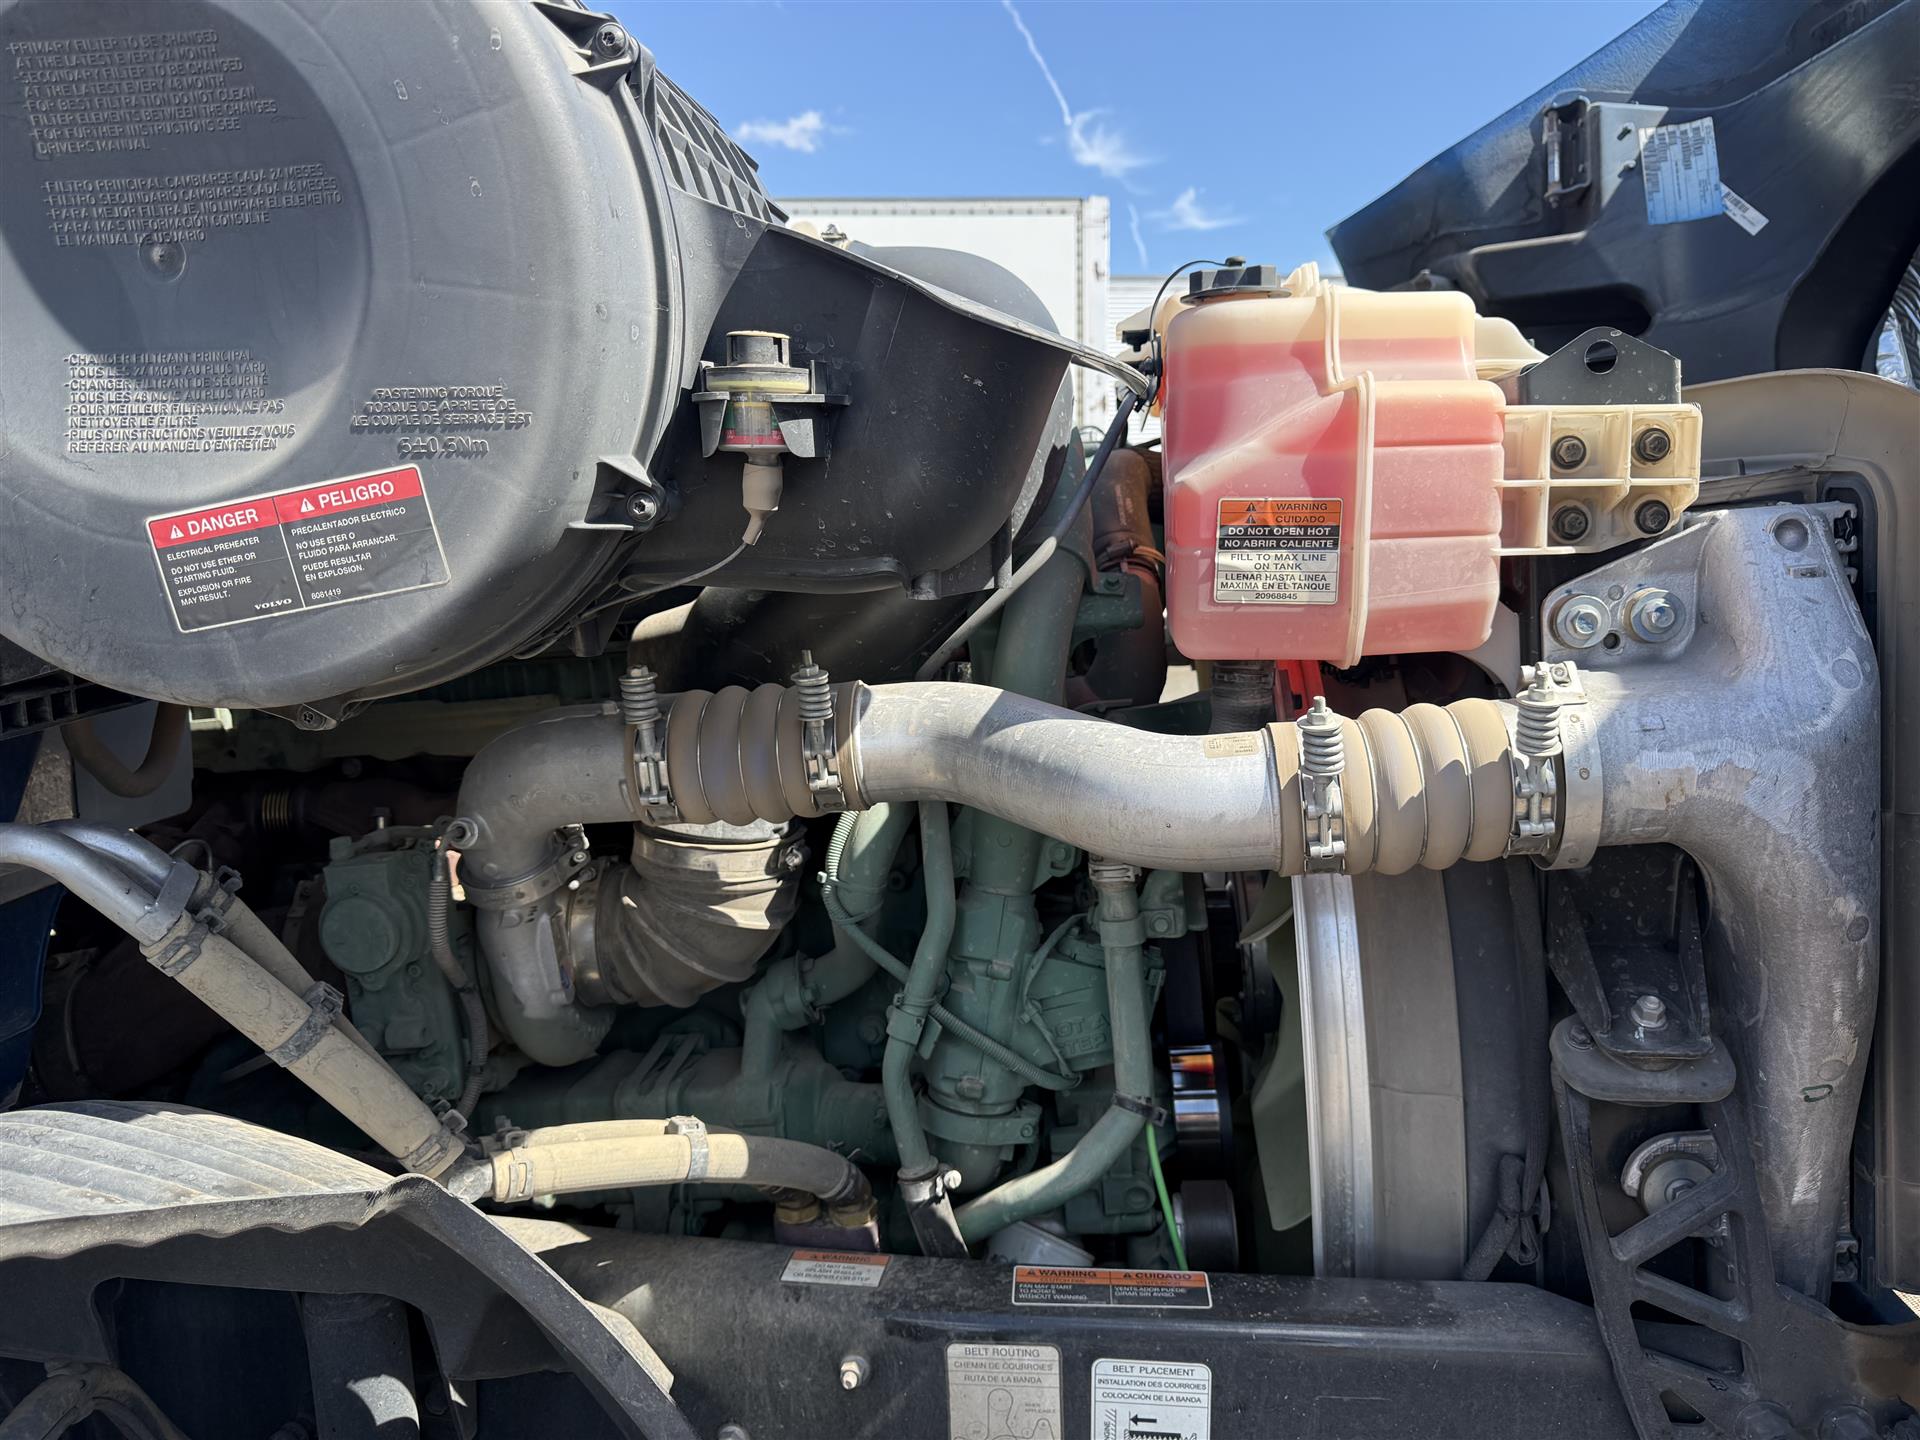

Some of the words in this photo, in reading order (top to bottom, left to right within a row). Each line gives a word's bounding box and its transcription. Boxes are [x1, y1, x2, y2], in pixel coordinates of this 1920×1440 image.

[375, 387, 448, 398] FASTENING
[450, 385, 504, 398] TORQUE
[108, 404, 168, 416] MEILLEUR
[242, 400, 260, 414] NE
[260, 399, 284, 414] PAS
[70, 417, 136, 428] NETTOYER
[140, 417, 154, 428] LE
[157, 416, 198, 428] FILTRE
[352, 415, 370, 426] LE
[372, 414, 420, 426] COUPLE
[423, 414, 441, 426] DE
[443, 412, 505, 425] SERRAGE
[508, 412, 533, 424] EST
[106, 428, 205, 442] D'INSTRUCTIONS
[208, 426, 262, 440] VEUILLEZ
[264, 424, 296, 439] VOUS
[132, 442, 148, 453] AU
[152, 440, 200, 453] MANUEL
[204, 439, 277, 452] D'ENTRETIEN
[318, 480, 394, 508] PELIGRO
[1276, 503, 1328, 511] WARNING
[187, 508, 259, 536] DANGER
[291, 516, 360, 536] PRECALENTADOR
[361, 506, 406, 523] ELECTRICO
[1276, 515, 1326, 524] CUIDADO
[1228, 528, 1244, 536] DO
[1248, 528, 1270, 536] NOT
[1273, 528, 1304, 536] OPEN
[1307, 528, 1332, 536] HOT
[296, 540, 308, 550] NO
[310, 538, 325, 548] USE
[326, 534, 348, 544] ETER
[348, 532, 356, 540] O
[298, 548, 328, 560] FLUIDO
[328, 543, 351, 554] PARA
[352, 534, 398, 550] ARRANCAR.
[1224, 540, 1241, 548] NO
[1243, 540, 1277, 548] ABRIR
[167, 545, 214, 561] ELECTRICAL
[214, 536, 260, 552] PREHEATER
[171, 566, 183, 576] DO
[184, 563, 200, 574] NOT
[201, 558, 217, 568] USE
[218, 554, 244, 566] ETHER
[244, 552, 256, 561] OR
[302, 560, 330, 572] PUEDE
[330, 552, 372, 566] RESULTAR
[1254, 562, 1270, 570] ON
[1273, 562, 1302, 570] TANK
[174, 570, 212, 585] STARTING
[212, 566, 238, 578] FLUID.
[305, 573, 317, 582] EN
[318, 564, 365, 580] EXPLOSION.
[1265, 574, 1296, 582] HASTA
[178, 582, 220, 597] EXPLOSION
[222, 578, 234, 588] OR
[234, 576, 252, 586] FIRE
[1292, 582, 1331, 590] TANQUE
[180, 596, 198, 607] MAY
[198, 590, 230, 603] RESULT.
[254, 598, 292, 610] VOLVO
[1040, 1270, 1097, 1278] WARNING
[964, 1346, 989, 1356] BELT
[992, 1348, 1040, 1358] ROUTING
[954, 1360, 986, 1369] CHEMIN
[1002, 1362, 1053, 1371] COURROIES
[1113, 1364, 1135, 1374] BELT
[1140, 1366, 1196, 1376] PLACEMENT
[964, 1374, 987, 1382] RUTA
[1098, 1378, 1146, 1388] INSTALLATION
[1164, 1382, 1206, 1390] COURROIES
